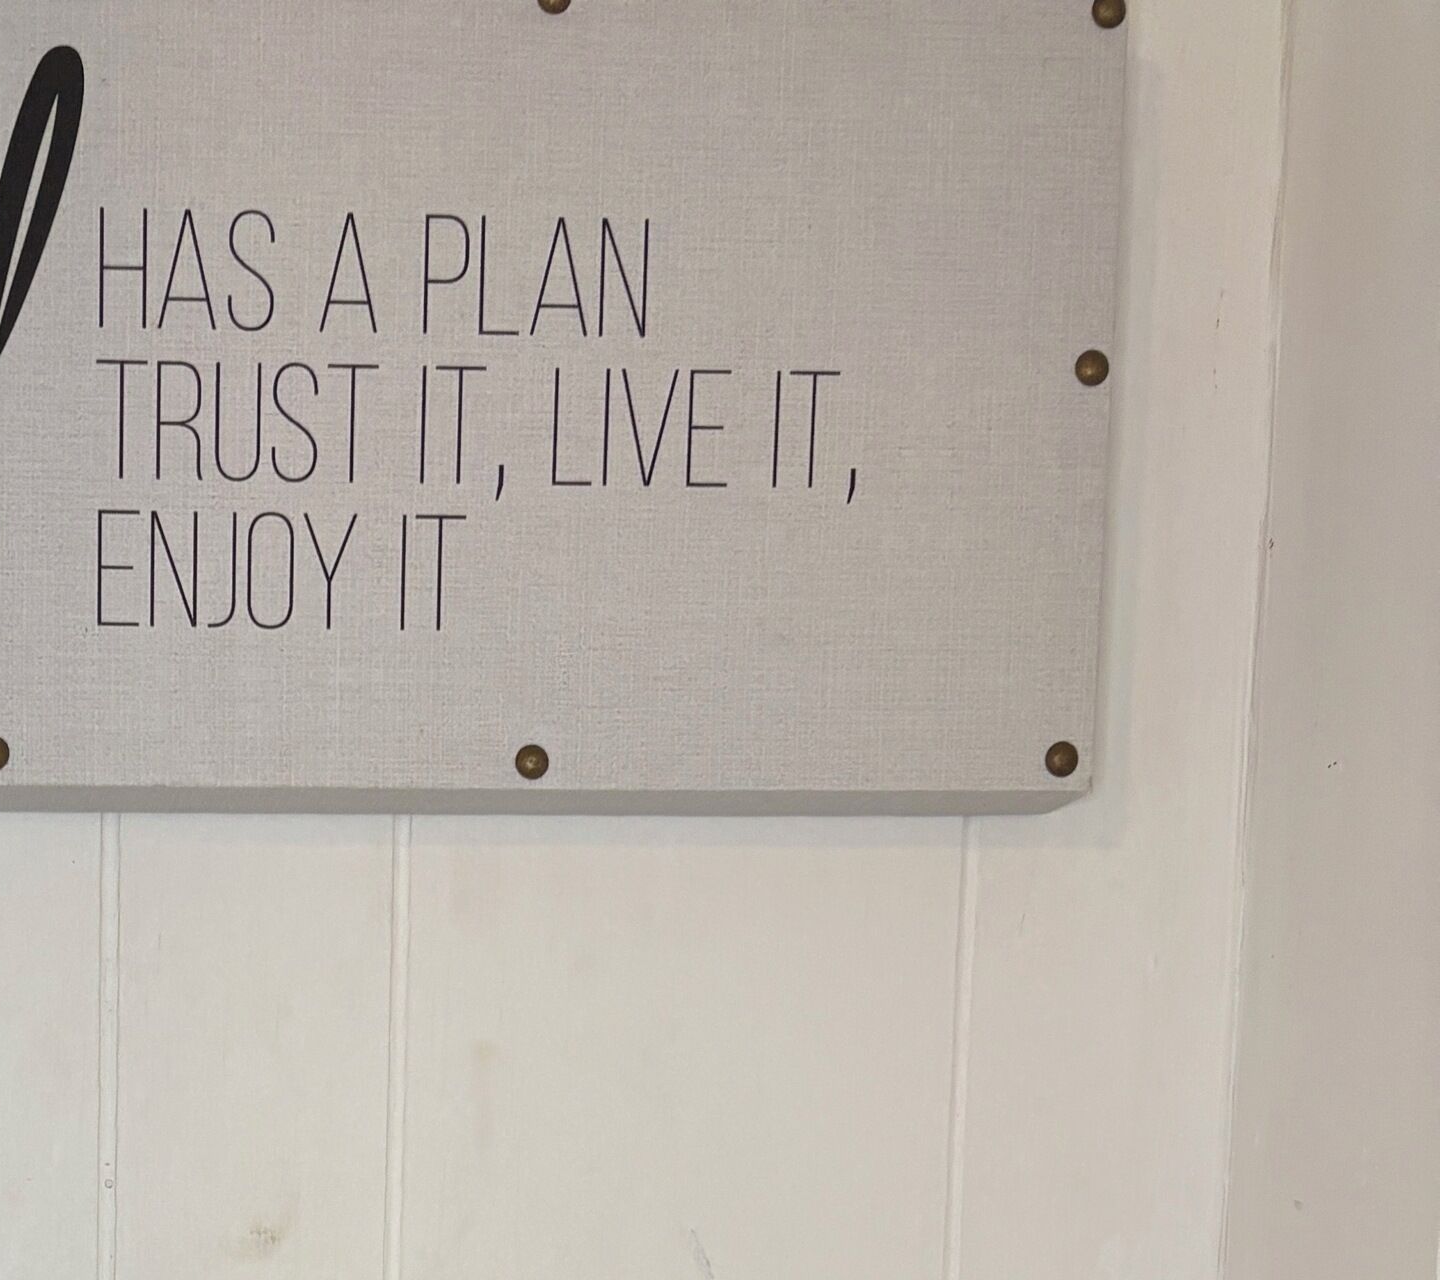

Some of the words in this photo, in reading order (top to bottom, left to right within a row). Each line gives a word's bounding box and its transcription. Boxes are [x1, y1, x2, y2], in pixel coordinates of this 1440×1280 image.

[97, 207, 277, 335] HAS
[320, 211, 378, 334] A
[421, 214, 651, 339] PLAN
[96, 359, 380, 486] TRUST
[419, 365, 506, 502] IT,
[550, 367, 733, 490] LIVE
[769, 370, 859, 506] IT,
[96, 510, 358, 631] ENJOY
[399, 514, 468, 631] IT
